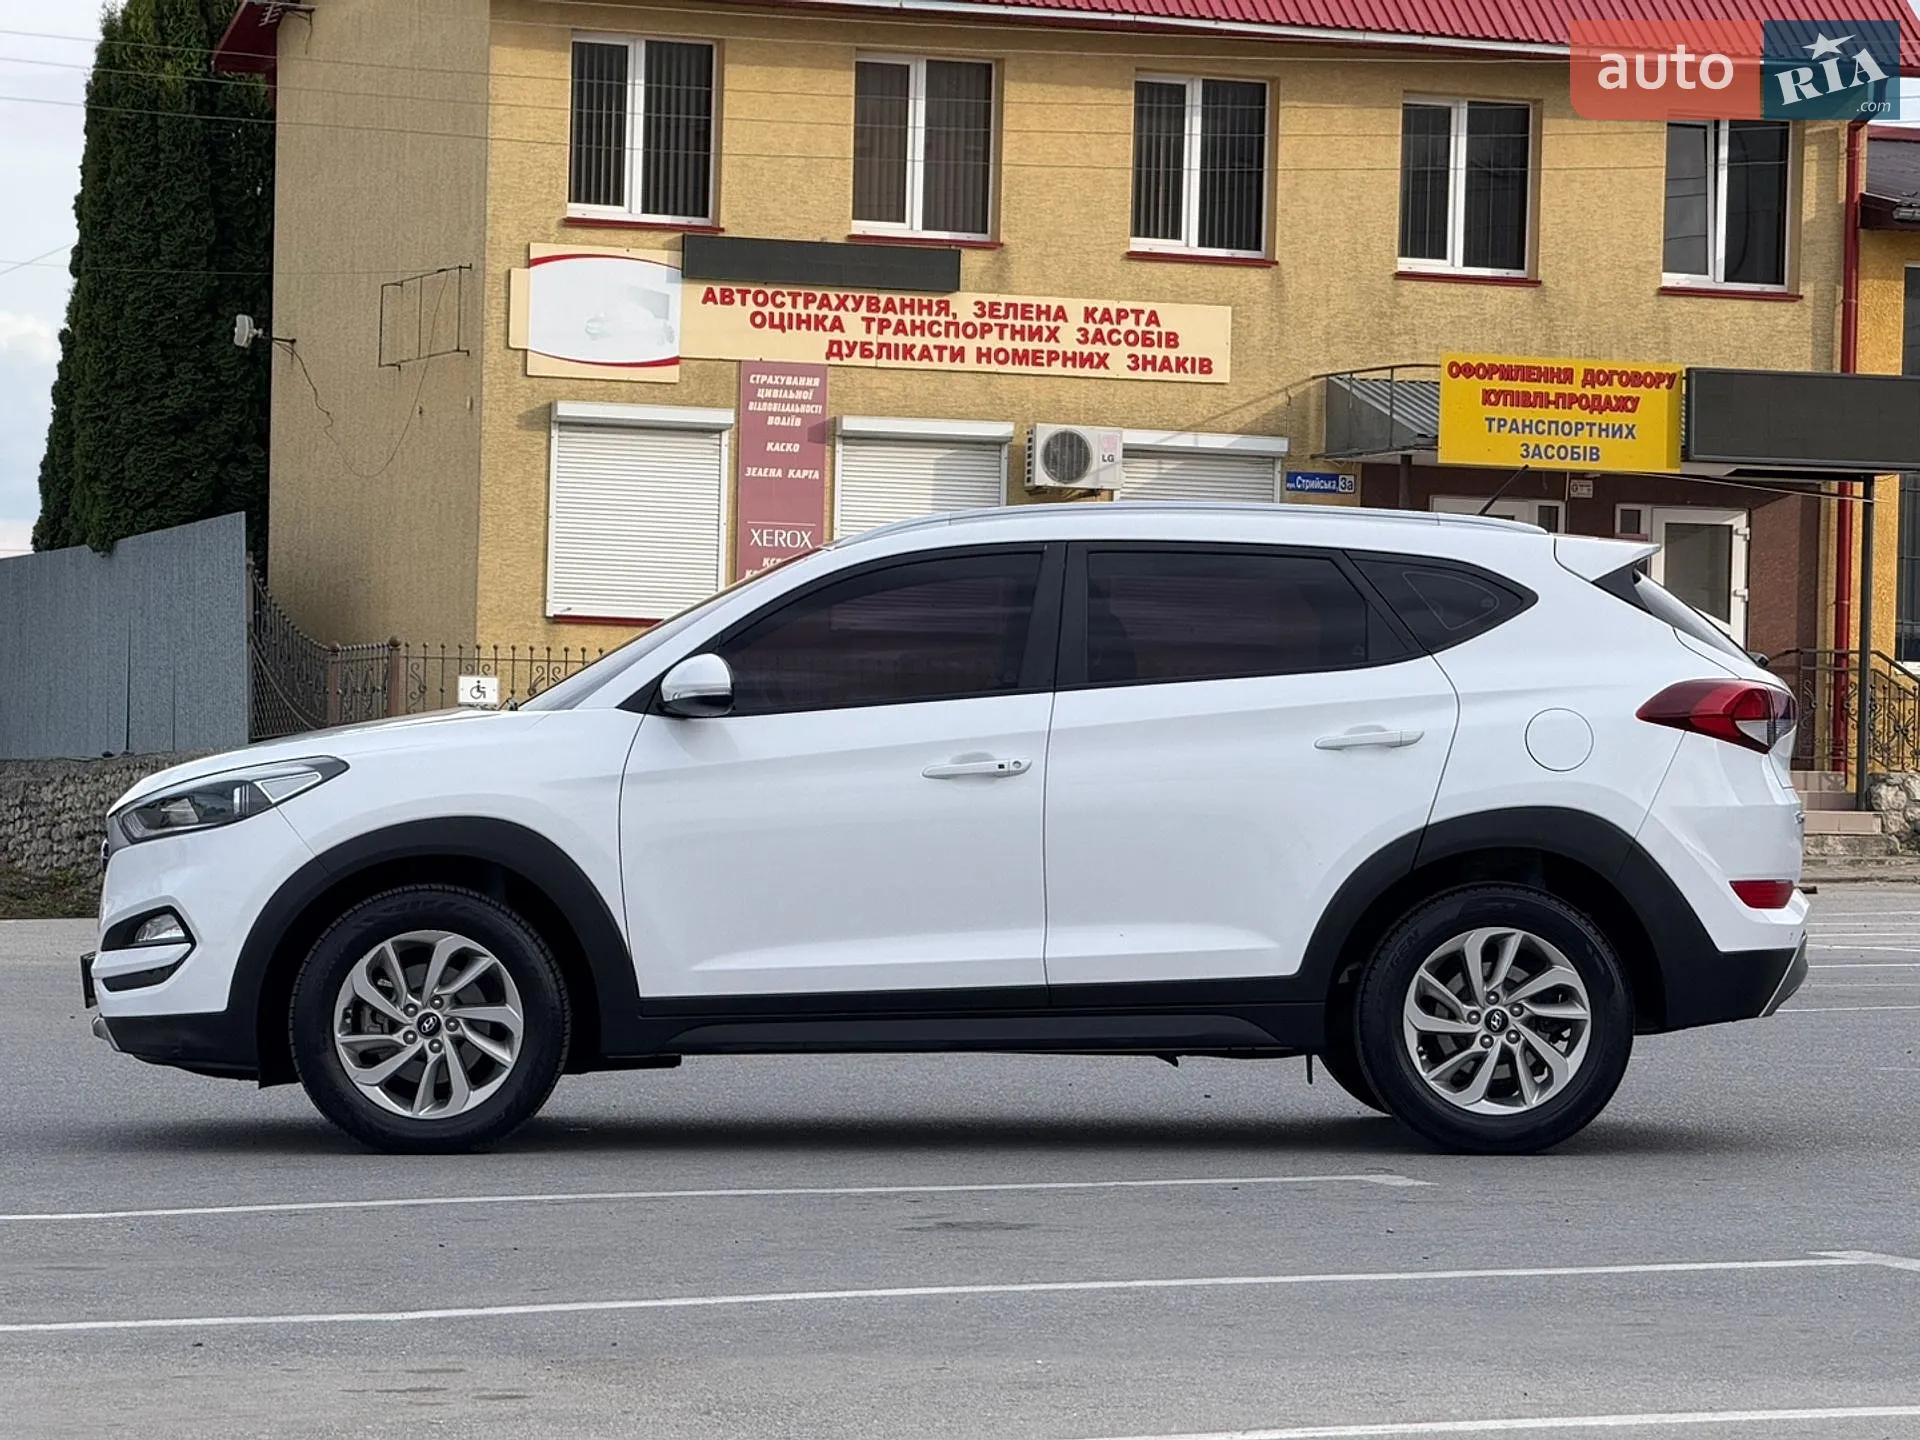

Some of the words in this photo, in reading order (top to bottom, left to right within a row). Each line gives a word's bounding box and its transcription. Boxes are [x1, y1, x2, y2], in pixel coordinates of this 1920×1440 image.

[701, 286, 957, 320] АВТОСТРАХУВАННЯ,
[973, 300, 1069, 323] ЗЕЛЕНА
[1083, 306, 1161, 328] КАРТА
[750, 310, 845, 333] ОЦІНКА
[861, 316, 1061, 344] ТРАНСПОРТНИХ
[1075, 327, 1180, 349] ЗАСОБІВ
[825, 339, 965, 363] ДУБЛІКАТИ
[975, 346, 1110, 370] НОМЕРНИХ
[1126, 353, 1214, 375] ЗНАКІВ
[749, 374, 821, 387] СТРАХУВАННЯ
[1447, 360, 1575, 385] ОФОРМЛЕННЯ
[1581, 368, 1678, 390] ДОГОВОРУ
[757, 388, 814, 400] ЦИВІЛЬНОЇ
[1481, 388, 1640, 414] КУПІВЛІ-ПРОДАЖУ
[767, 415, 802, 427] ВОДІЇВ
[1484, 416, 1637, 440] ТРАНСПОРТНИХ
[766, 442, 800, 453] КАСКО
[1520, 443, 1600, 462] ЗАСОБІВ
[1101, 453, 1115, 463] LG
[745, 466, 782, 478] ЗЕЛЕНА
[787, 468, 820, 480] КАРТА
[749, 528, 814, 550] XEROX
